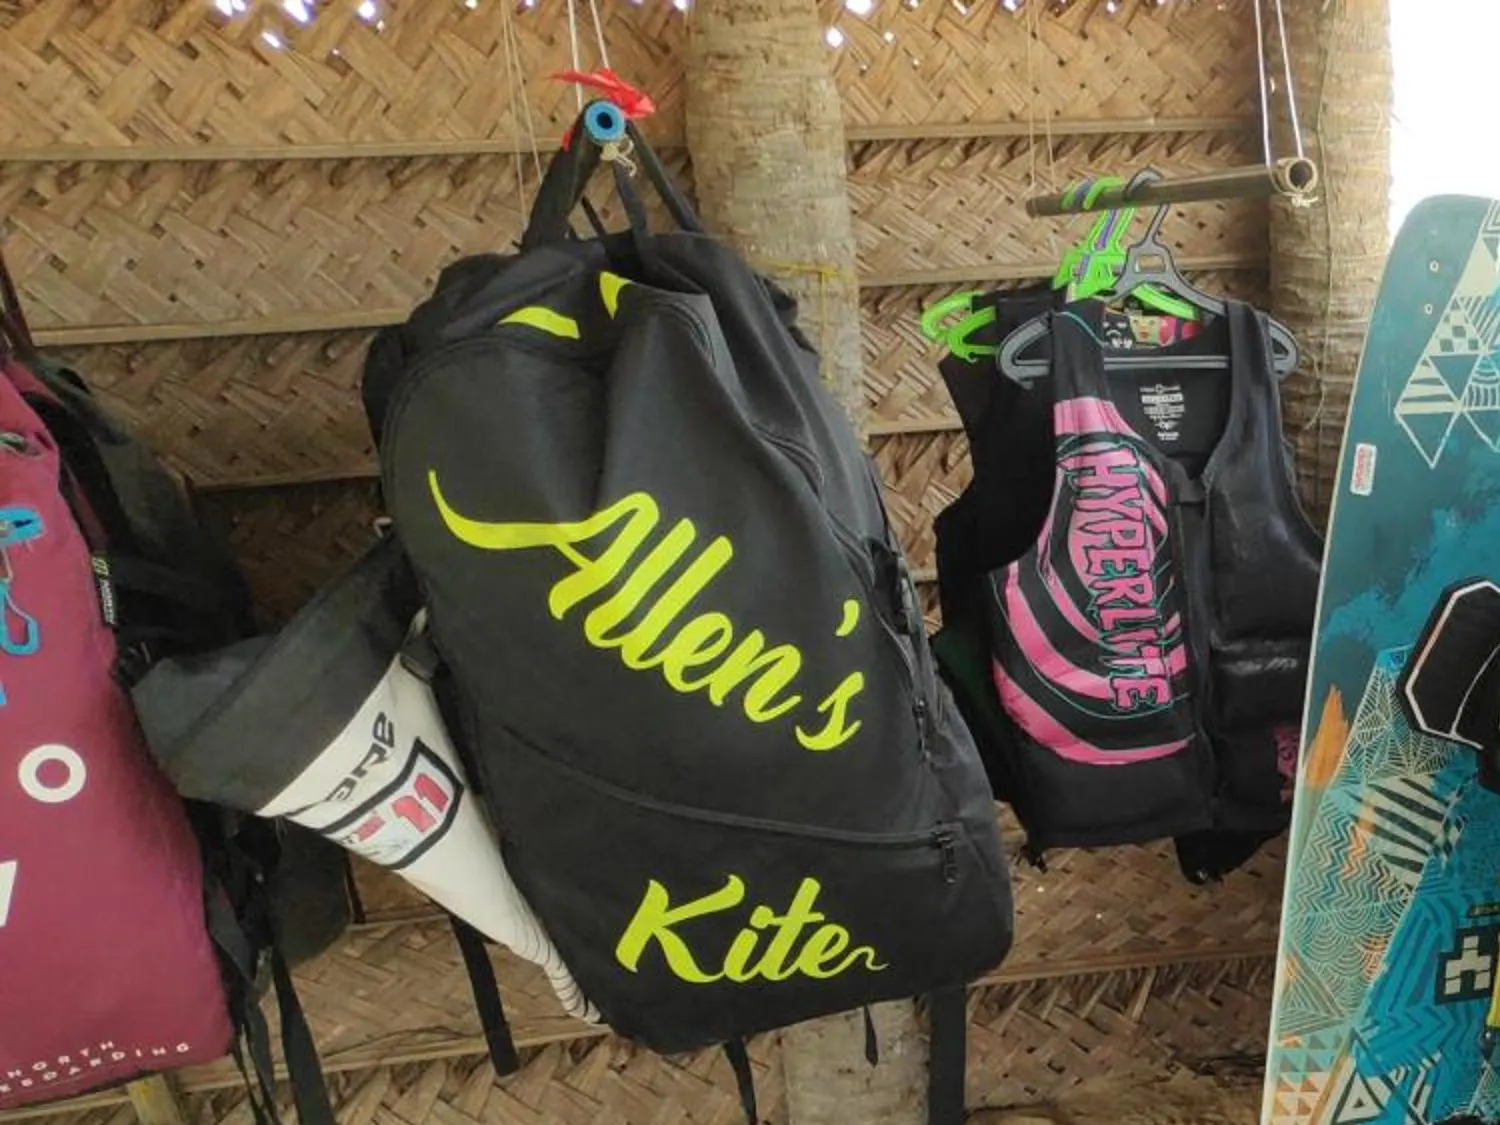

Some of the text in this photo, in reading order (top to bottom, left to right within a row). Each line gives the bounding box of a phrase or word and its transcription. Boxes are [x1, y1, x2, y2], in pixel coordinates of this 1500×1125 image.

[427, 469, 866, 752] Allen's
[1058, 447, 1171, 710] HYPERLITE
[614, 875, 888, 983] Kite
[7, 1040, 115, 1079] NORTH
